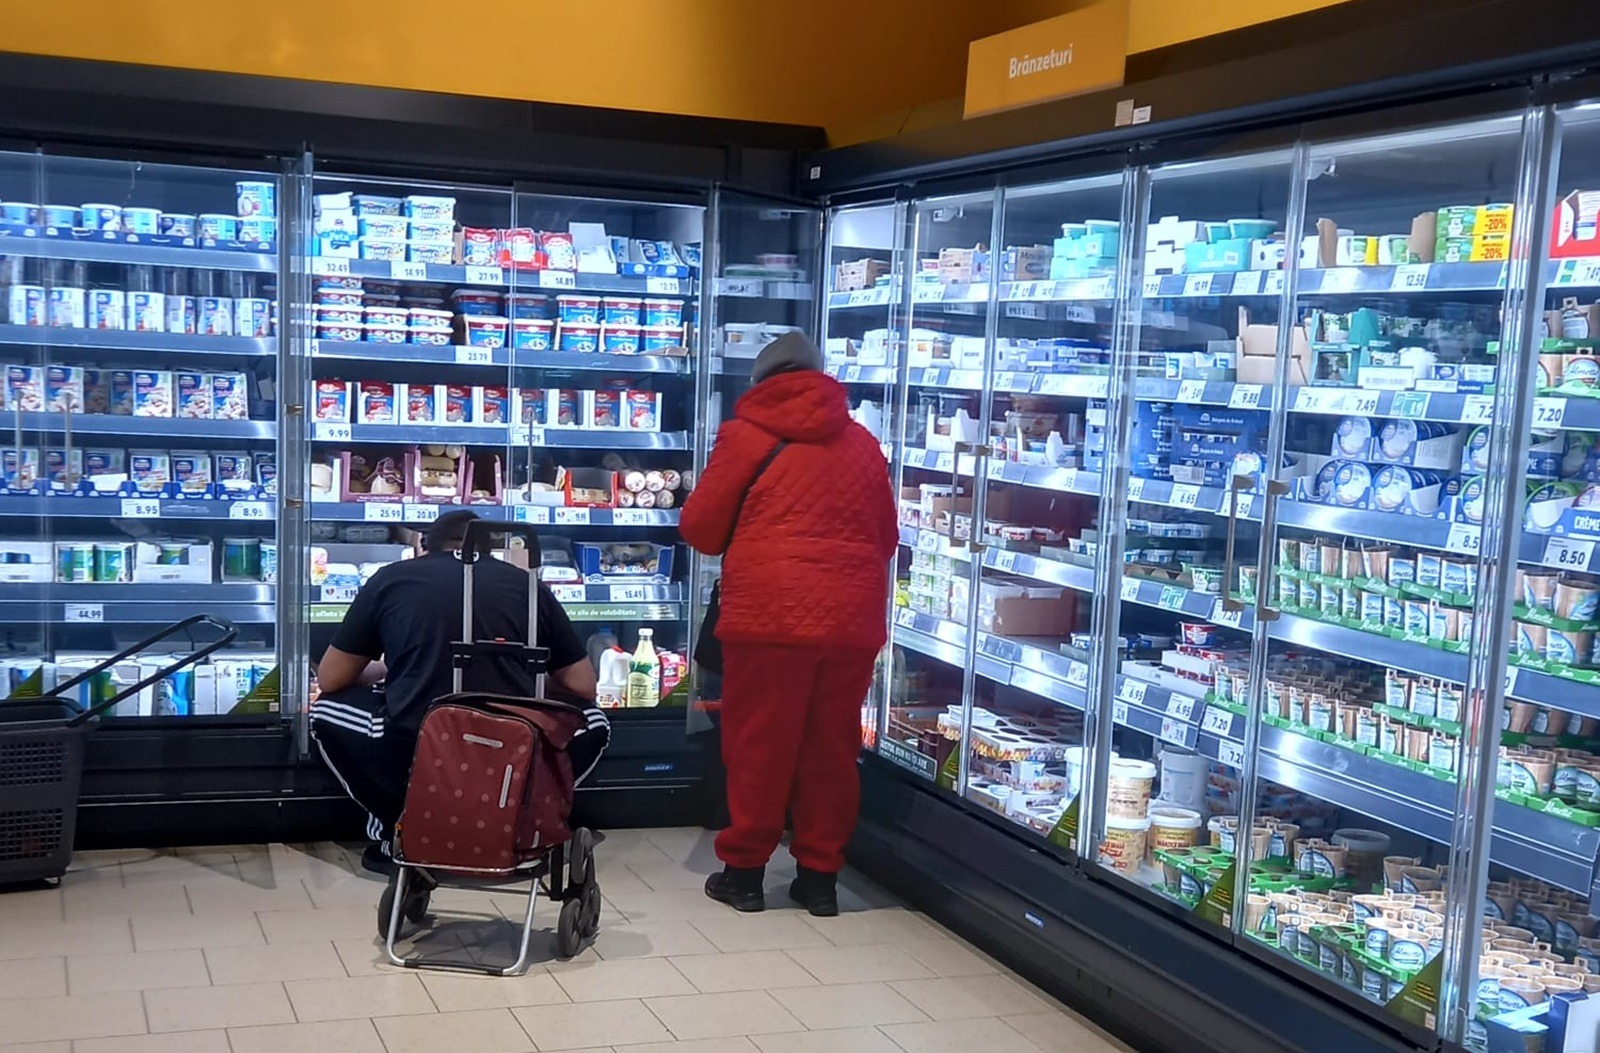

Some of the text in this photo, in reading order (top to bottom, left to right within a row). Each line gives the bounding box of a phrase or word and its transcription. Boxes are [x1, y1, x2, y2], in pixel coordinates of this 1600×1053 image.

[1009, 44, 1073, 79] Brânzeturi
[1485, 218, 1507, 230] -20%
[1481, 248, 1502, 260] -20%
[1479, 405, 1494, 418] 7.2
[1537, 408, 1562, 422] 7.20
[329, 428, 349, 438] 9.99
[136, 505, 158, 515] 8.95
[380, 509, 400, 518] 25.99
[1463, 535, 1480, 549] 8.5
[1559, 550, 1585, 565] 8.50
[1129, 687, 1143, 701] 6.95
[1175, 703, 1191, 717] 6.95
[1211, 718, 1229, 731] 7.20
